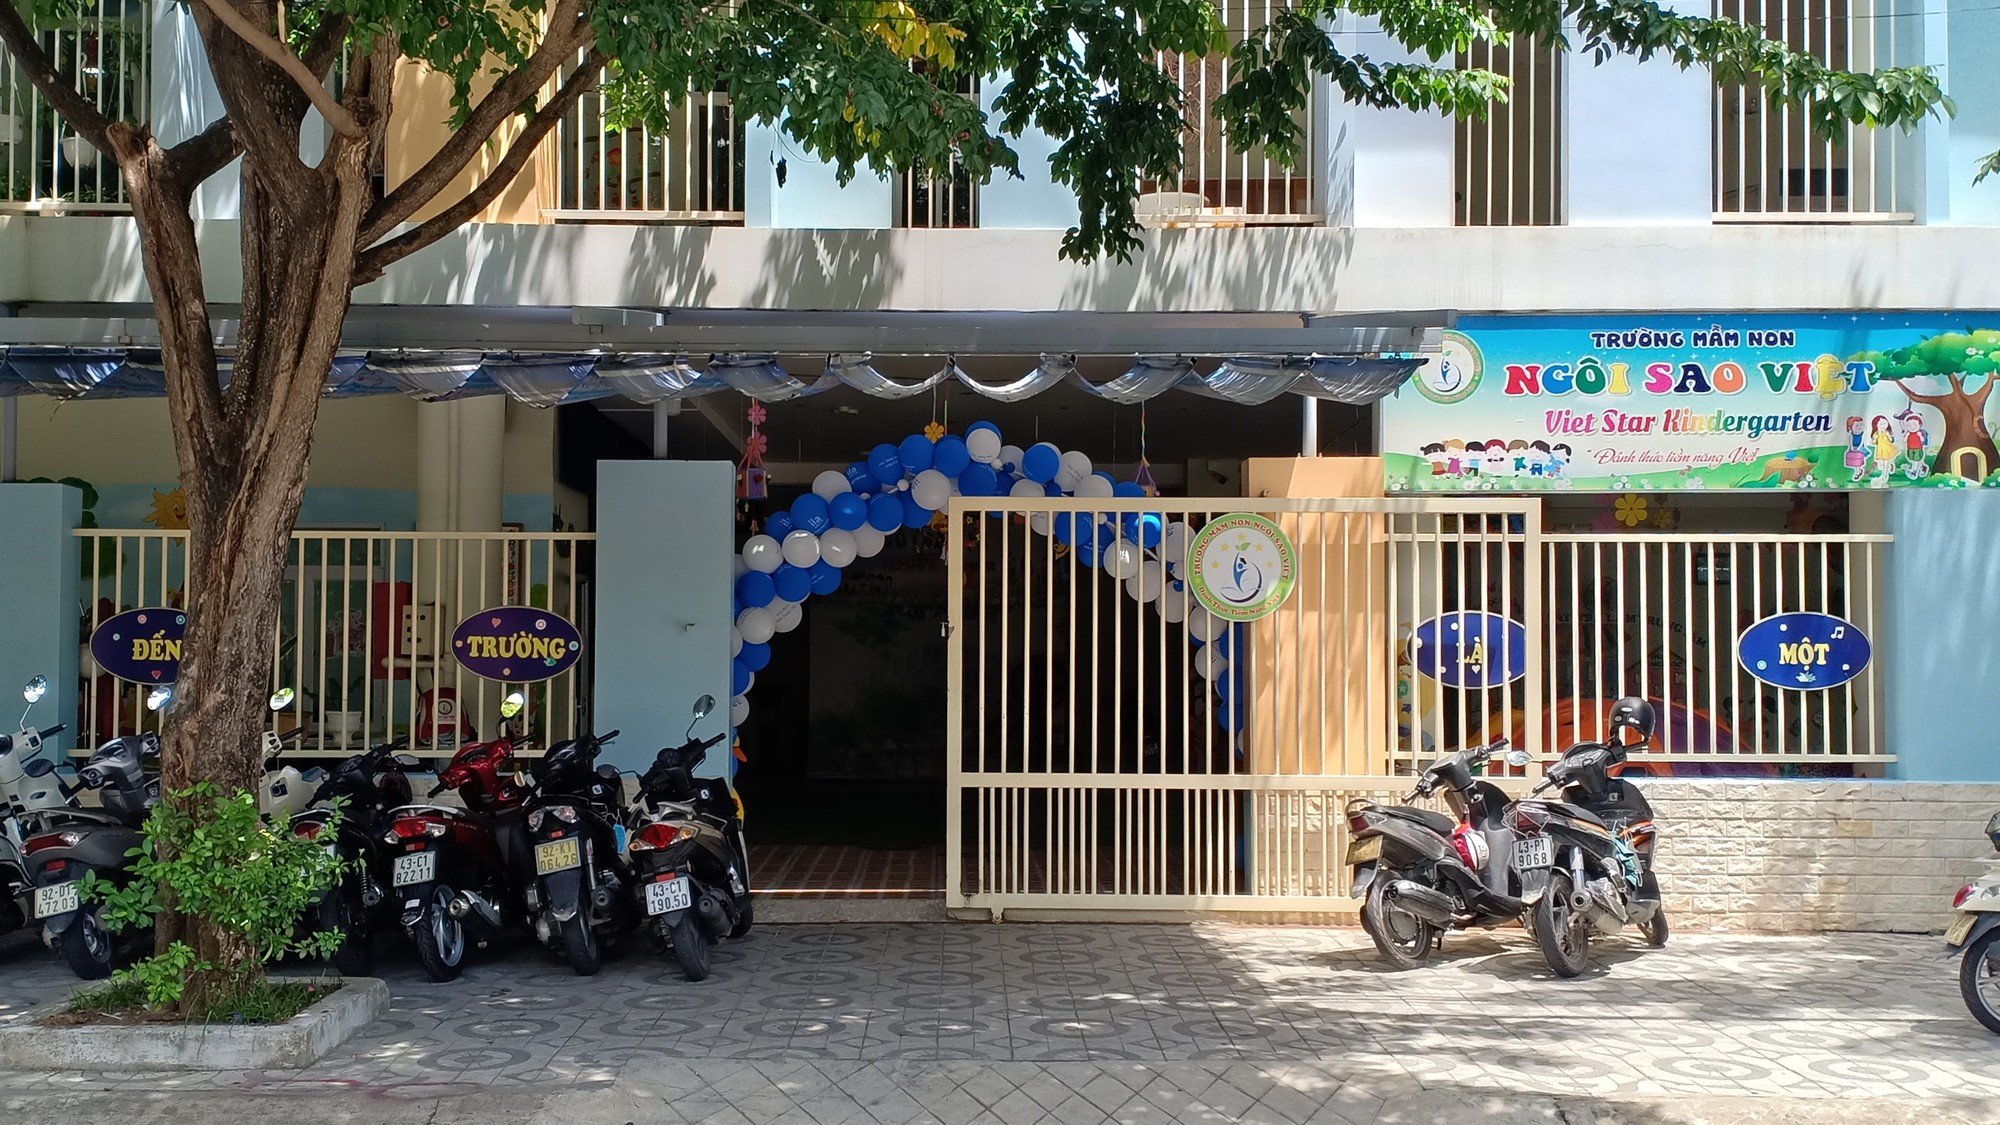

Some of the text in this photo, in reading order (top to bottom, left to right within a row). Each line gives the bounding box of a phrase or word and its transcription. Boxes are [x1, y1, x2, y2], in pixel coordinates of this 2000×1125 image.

[1592, 325, 1795, 347] TRƯỜNG MẦM NON
[1504, 357, 1630, 395] NGÔI
[1645, 363, 1745, 394] SAO
[1759, 354, 1875, 400] VIỆT
[1546, 409, 1832, 438] Viet Star Kindergarten
[131, 629, 182, 662] ĐẾN
[467, 630, 567, 661] TRƯỜNG
[1778, 636, 1830, 670] MỘT
[542, 839, 572, 857] 92-K1
[1517, 839, 1546, 855] 43-P1
[400, 855, 428, 871] 43-C1
[540, 852, 577, 872] 064.26
[1518, 853, 1547, 867] 9068
[396, 866, 431, 884] 822.11
[652, 879, 682, 897] 43-C1
[38, 896, 76, 916] 472.03
[651, 894, 688, 913] 190.50
